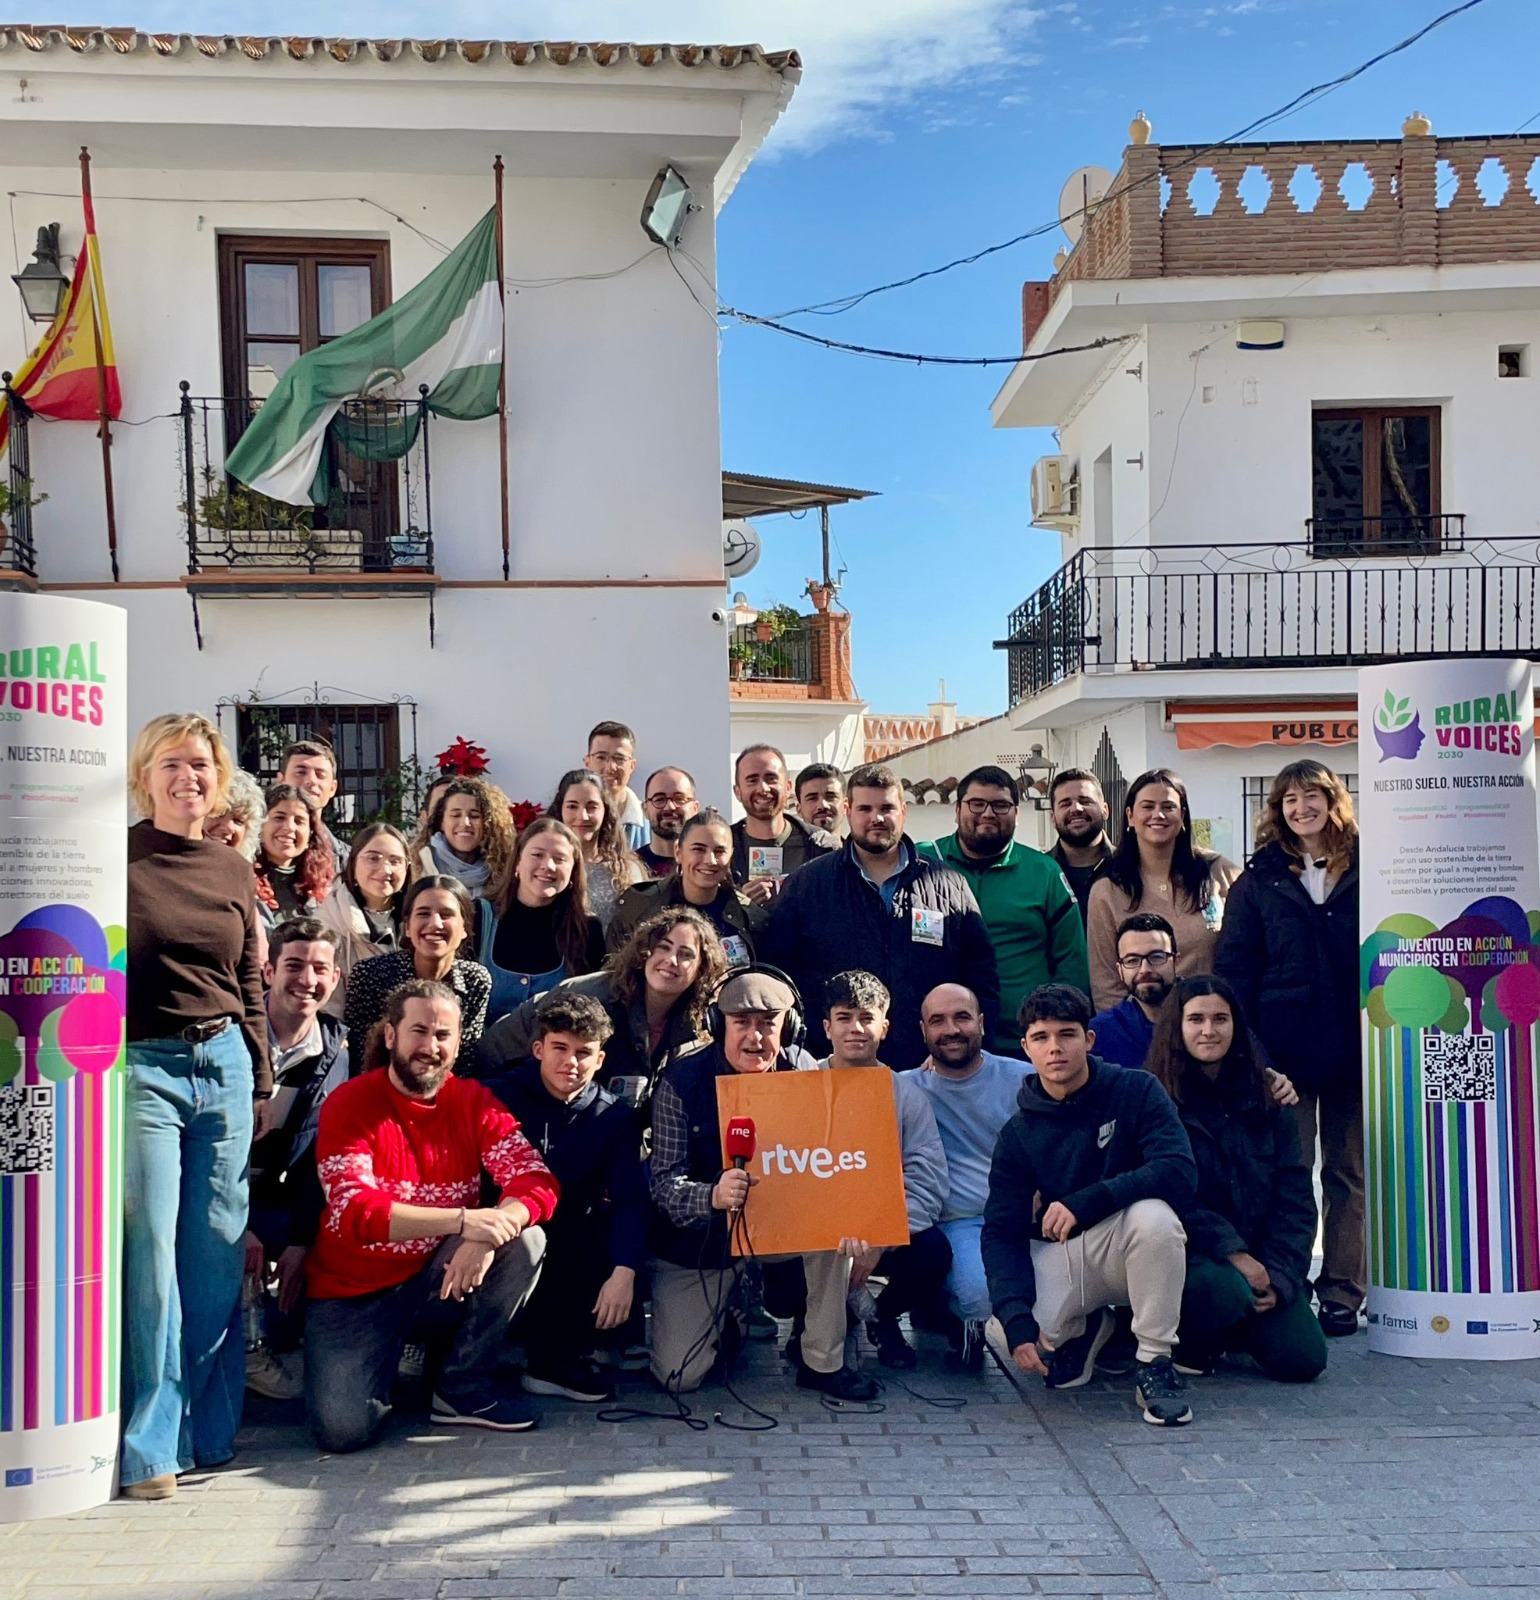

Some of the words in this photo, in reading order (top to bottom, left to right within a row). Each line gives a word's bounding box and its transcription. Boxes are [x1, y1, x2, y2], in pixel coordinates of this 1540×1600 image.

[1435, 690, 1522, 726] RURAL
[1272, 723, 1325, 739] PUB
[1435, 725, 1521, 756] VOICES
[8, 746, 66, 763] NUESTRA
[69, 748, 107, 767] ACCIÓN
[1438, 751, 1463, 759] 2030
[1374, 779, 1413, 792] NUESTRO
[1415, 777, 1450, 790] SUELO,
[1453, 775, 1496, 788] NUESTRA
[1498, 773, 1524, 787] ACCIÓN
[24, 836, 78, 847] trabajamos
[1425, 845, 1464, 853] Andalucía
[1467, 844, 1506, 852] trabajamos
[37, 850, 49, 858] de
[53, 851, 61, 859] la
[62, 852, 86, 860] tierra
[1434, 855, 1474, 863] sostenible
[19, 863, 58, 875] mujeres
[60, 866, 65, 875] y
[67, 863, 103, 874] hombres
[1434, 866, 1454, 875] igual
[1462, 866, 1491, 875] mujeres
[1499, 864, 1524, 872] hombres
[49, 889, 64, 899] del
[67, 890, 90, 899] suelo
[1440, 886, 1484, 895] protectoras
[1397, 937, 1454, 952] JUVENTUD
[1457, 937, 1472, 951] EN
[1475, 934, 1512, 951] ACCIÓN
[8, 957, 29, 975] EN
[31, 954, 83, 975] ACCIÓN
[1379, 953, 1440, 967] MUNICIPIOS
[1443, 953, 1458, 967] EN
[1461, 949, 1529, 966] COOPERACIÓN
[14, 974, 105, 995] COOPERACIÓN
[731, 1128, 750, 1137] rne
[761, 1143, 867, 1178] rtve.es
[1382, 1313, 1418, 1330] famsi
